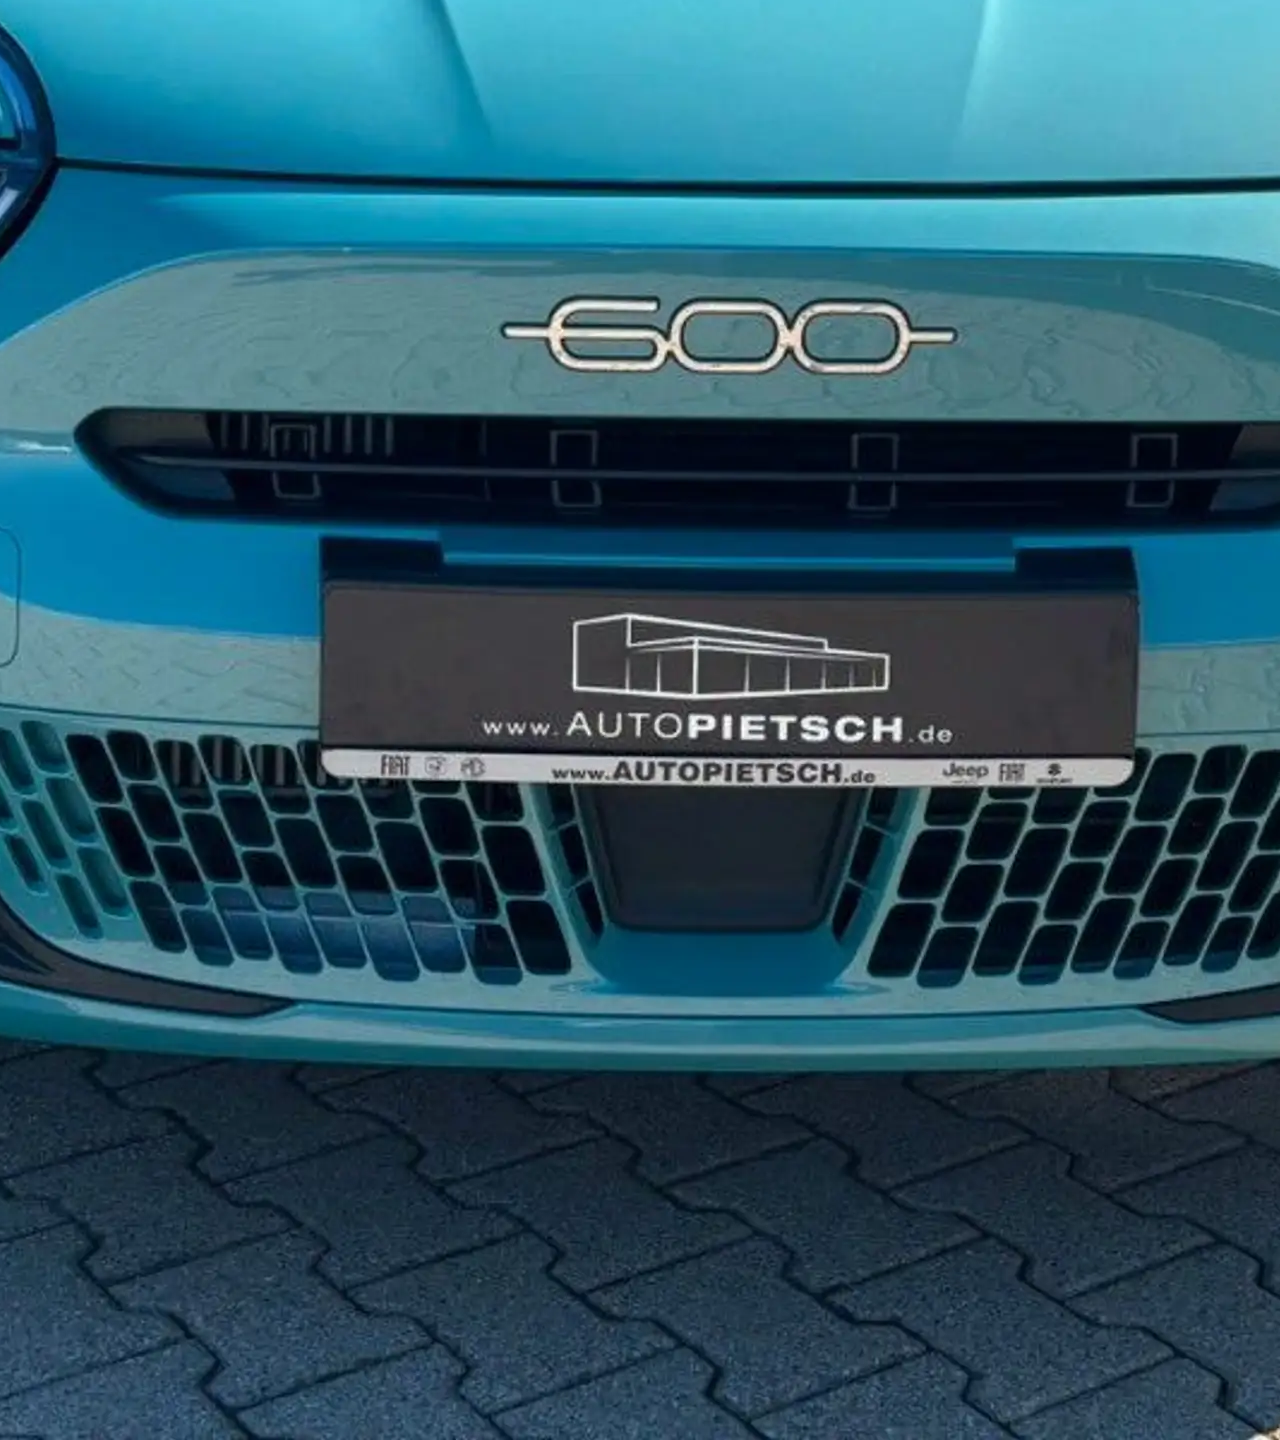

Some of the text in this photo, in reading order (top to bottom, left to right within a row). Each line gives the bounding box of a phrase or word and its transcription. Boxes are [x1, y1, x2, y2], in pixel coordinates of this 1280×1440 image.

[503, 296, 957, 372] 600
[482, 710, 953, 746] www.AUTOPIETSCH.de
[379, 752, 412, 777] FIAT
[551, 760, 876, 787] www.AUTOPIETSCH.de
[941, 761, 990, 780] Jeep
